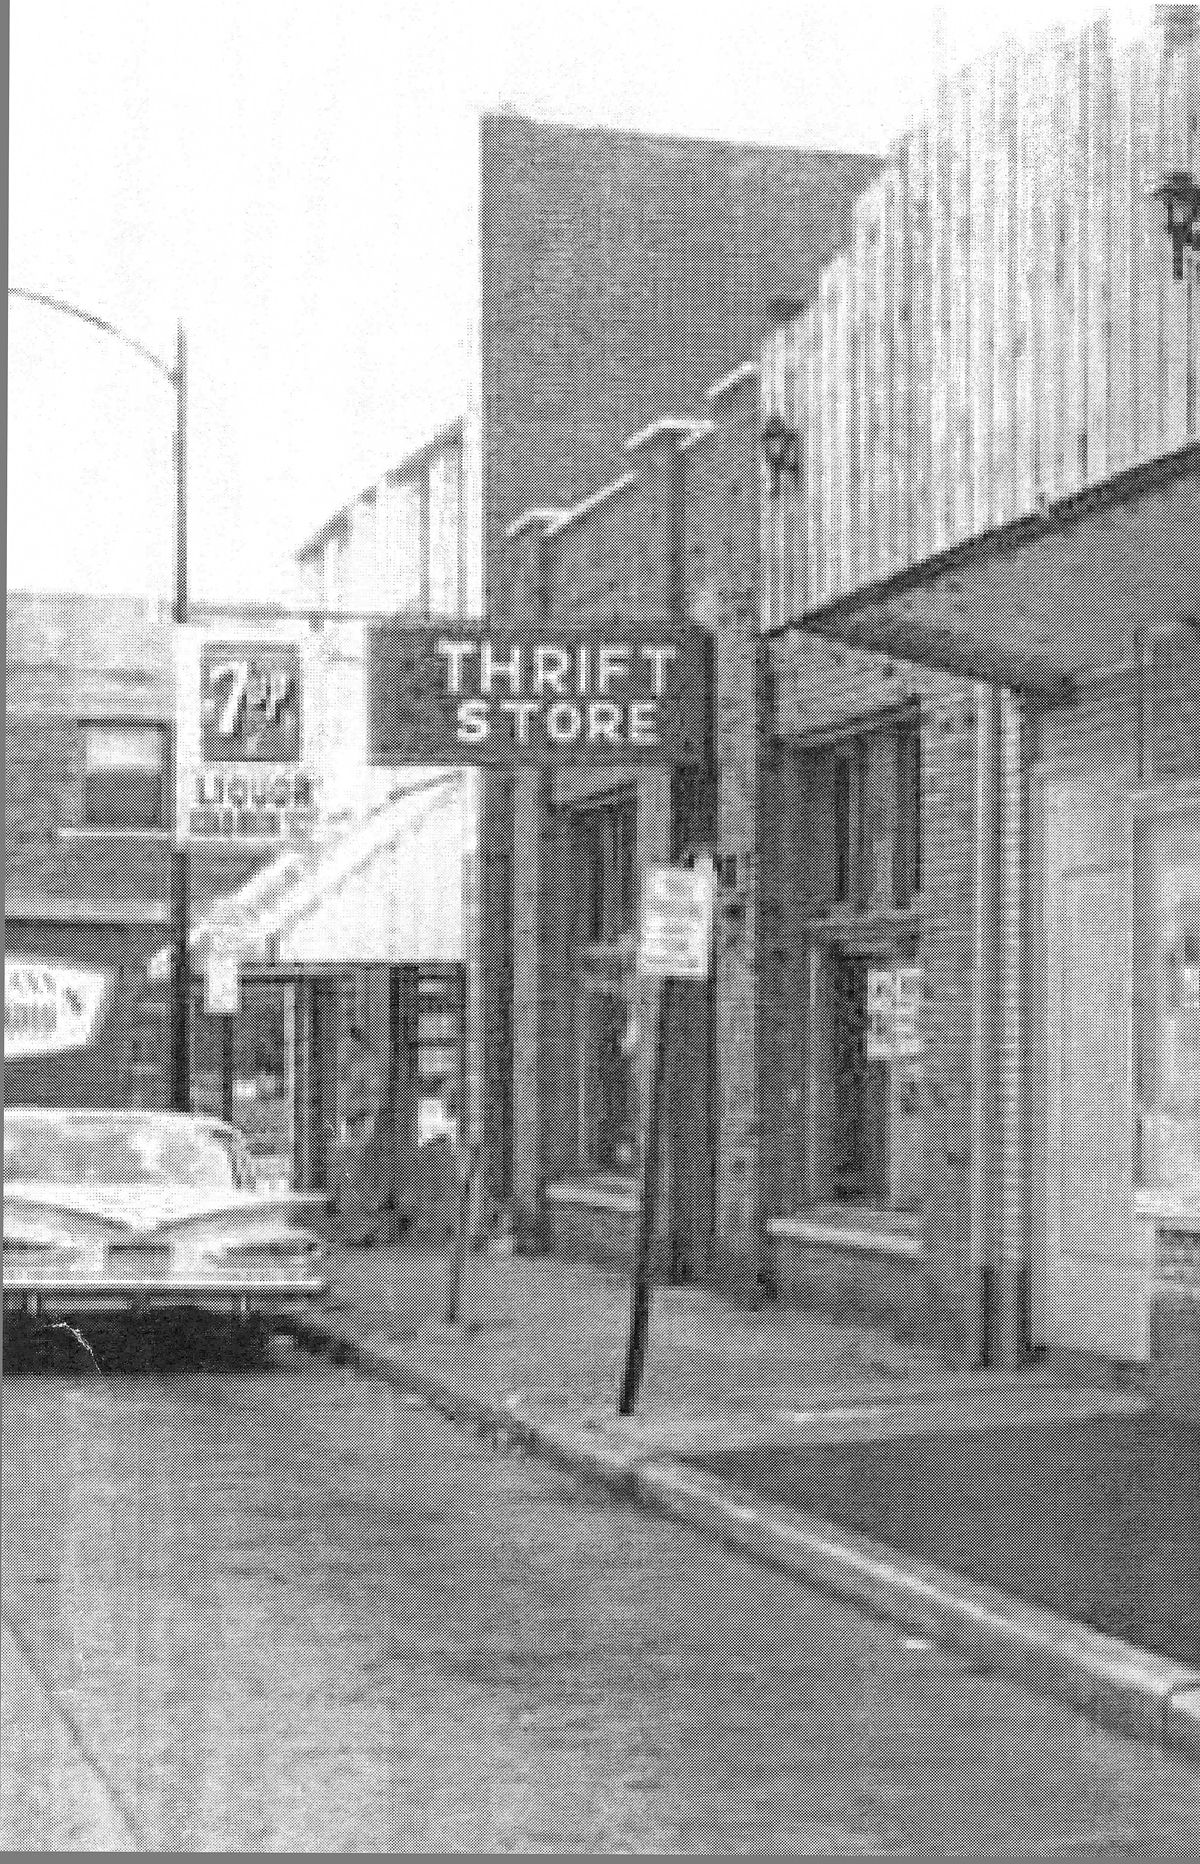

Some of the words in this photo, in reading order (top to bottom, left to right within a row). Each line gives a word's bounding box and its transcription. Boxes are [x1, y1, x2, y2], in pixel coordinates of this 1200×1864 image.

[435, 640, 677, 696] THRIFT
[455, 700, 662, 746] STORE
[195, 774, 314, 807] LIQUOR
